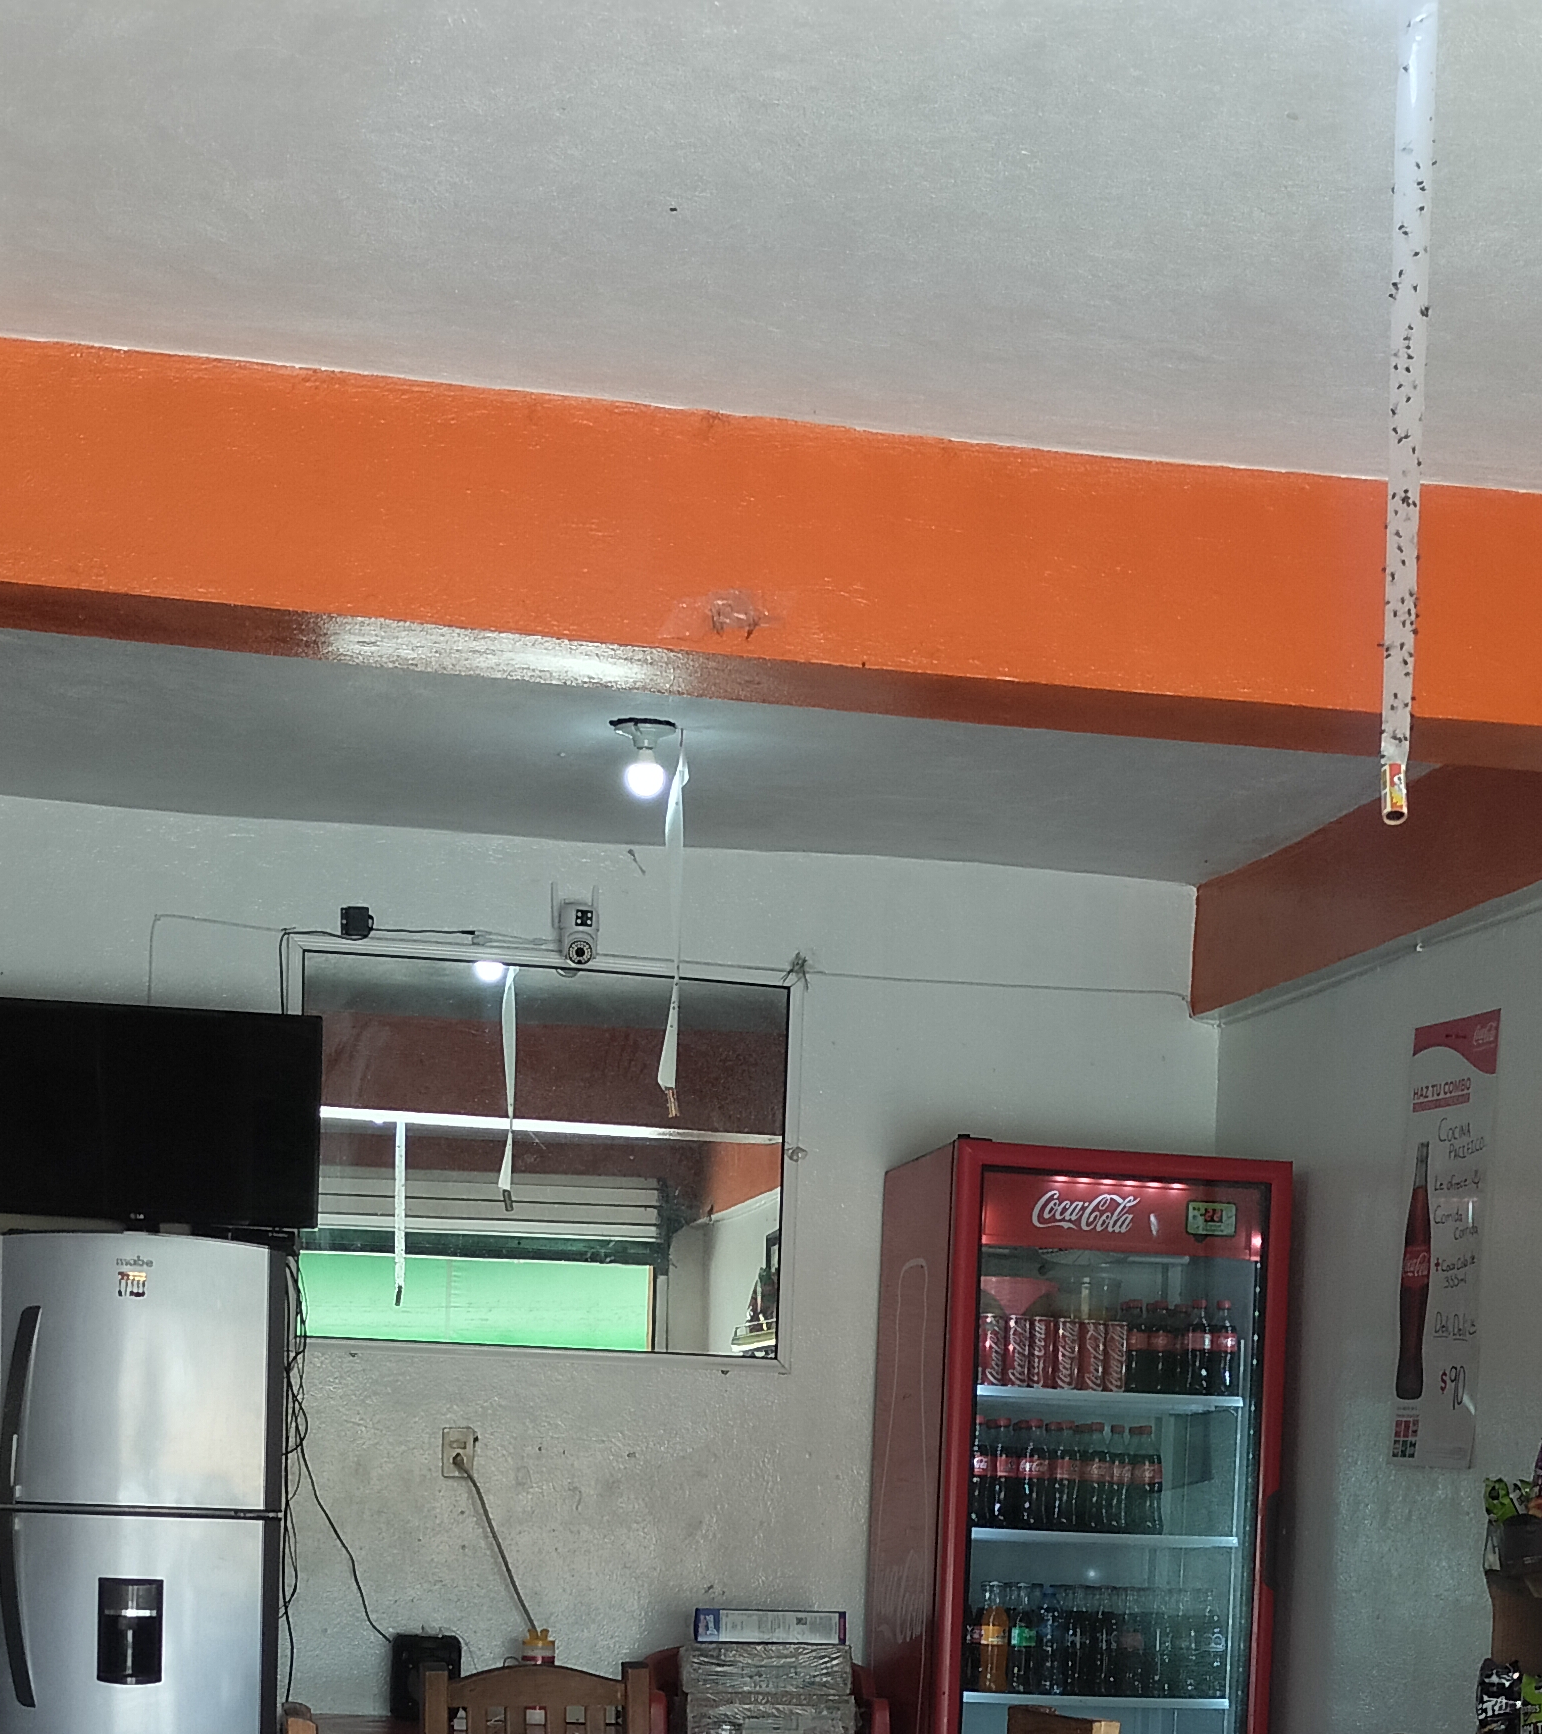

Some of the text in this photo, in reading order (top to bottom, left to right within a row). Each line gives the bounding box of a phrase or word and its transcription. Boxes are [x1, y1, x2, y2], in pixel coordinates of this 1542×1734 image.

[1412, 1077, 1471, 1101] HAZ TU COMBO
[1032, 1190, 1140, 1233] Coca-Cola
[116, 1255, 154, 1268] mabe
